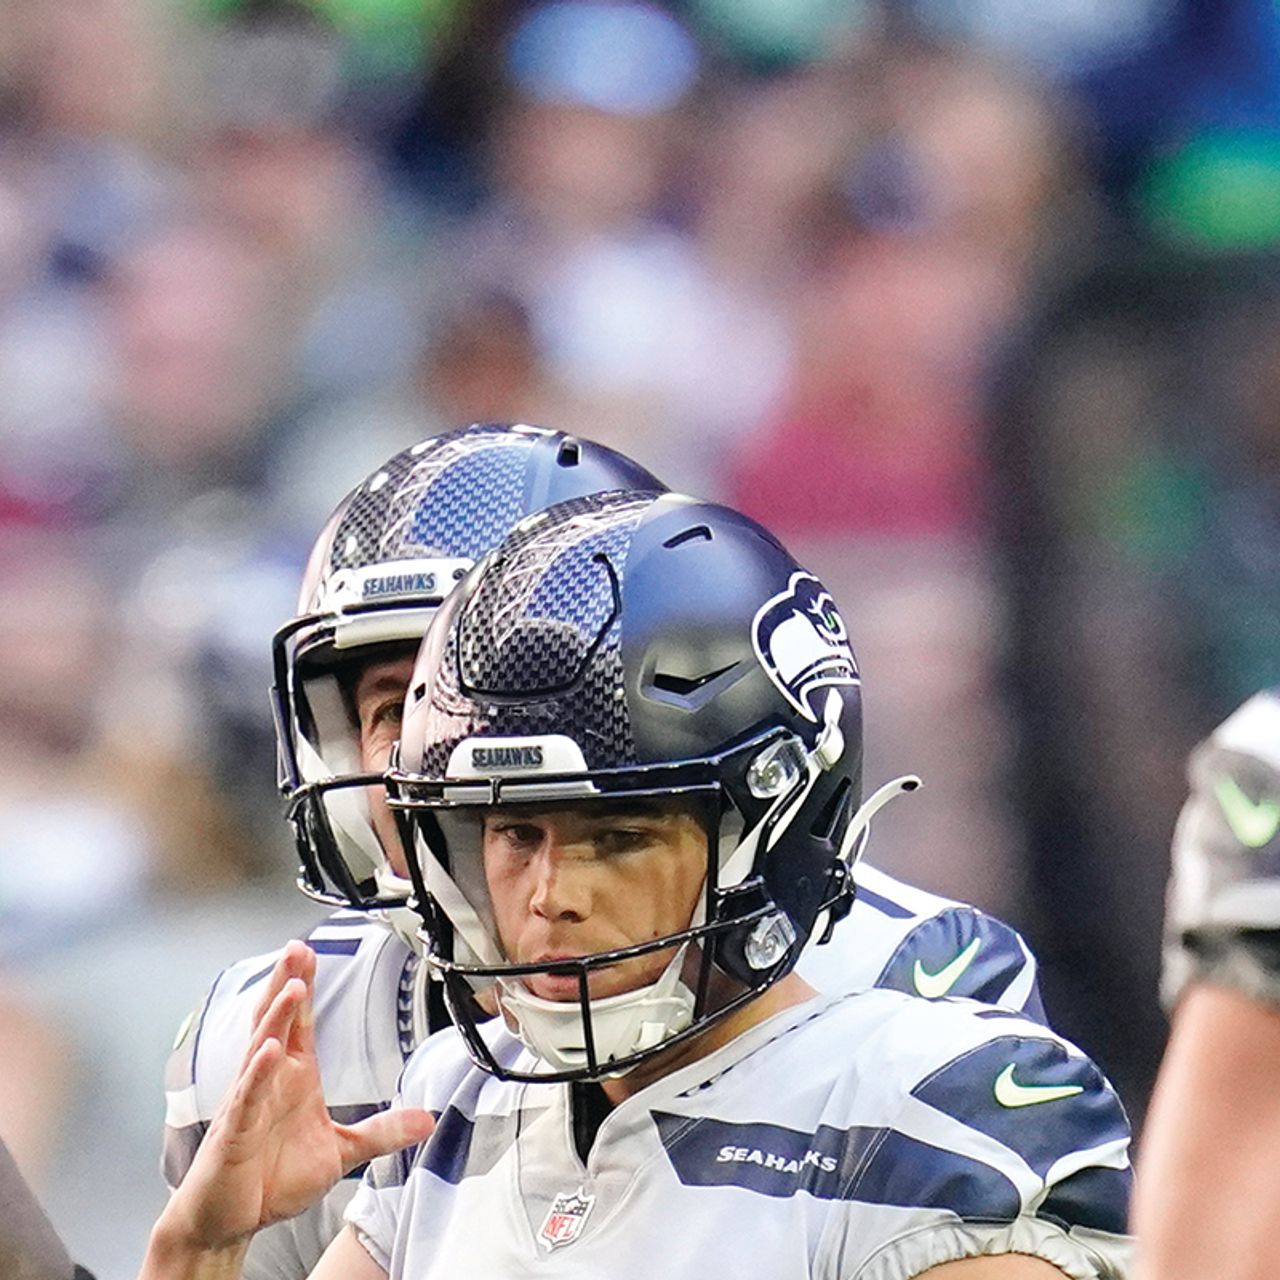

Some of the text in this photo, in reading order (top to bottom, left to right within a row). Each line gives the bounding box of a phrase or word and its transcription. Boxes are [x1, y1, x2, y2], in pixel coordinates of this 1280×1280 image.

[362, 572, 437, 597] SEAHAWKS
[471, 745, 544, 768] SEAHAWKS
[716, 1145, 838, 1173] SEAHAKS
[544, 1215, 577, 1239] NFL
